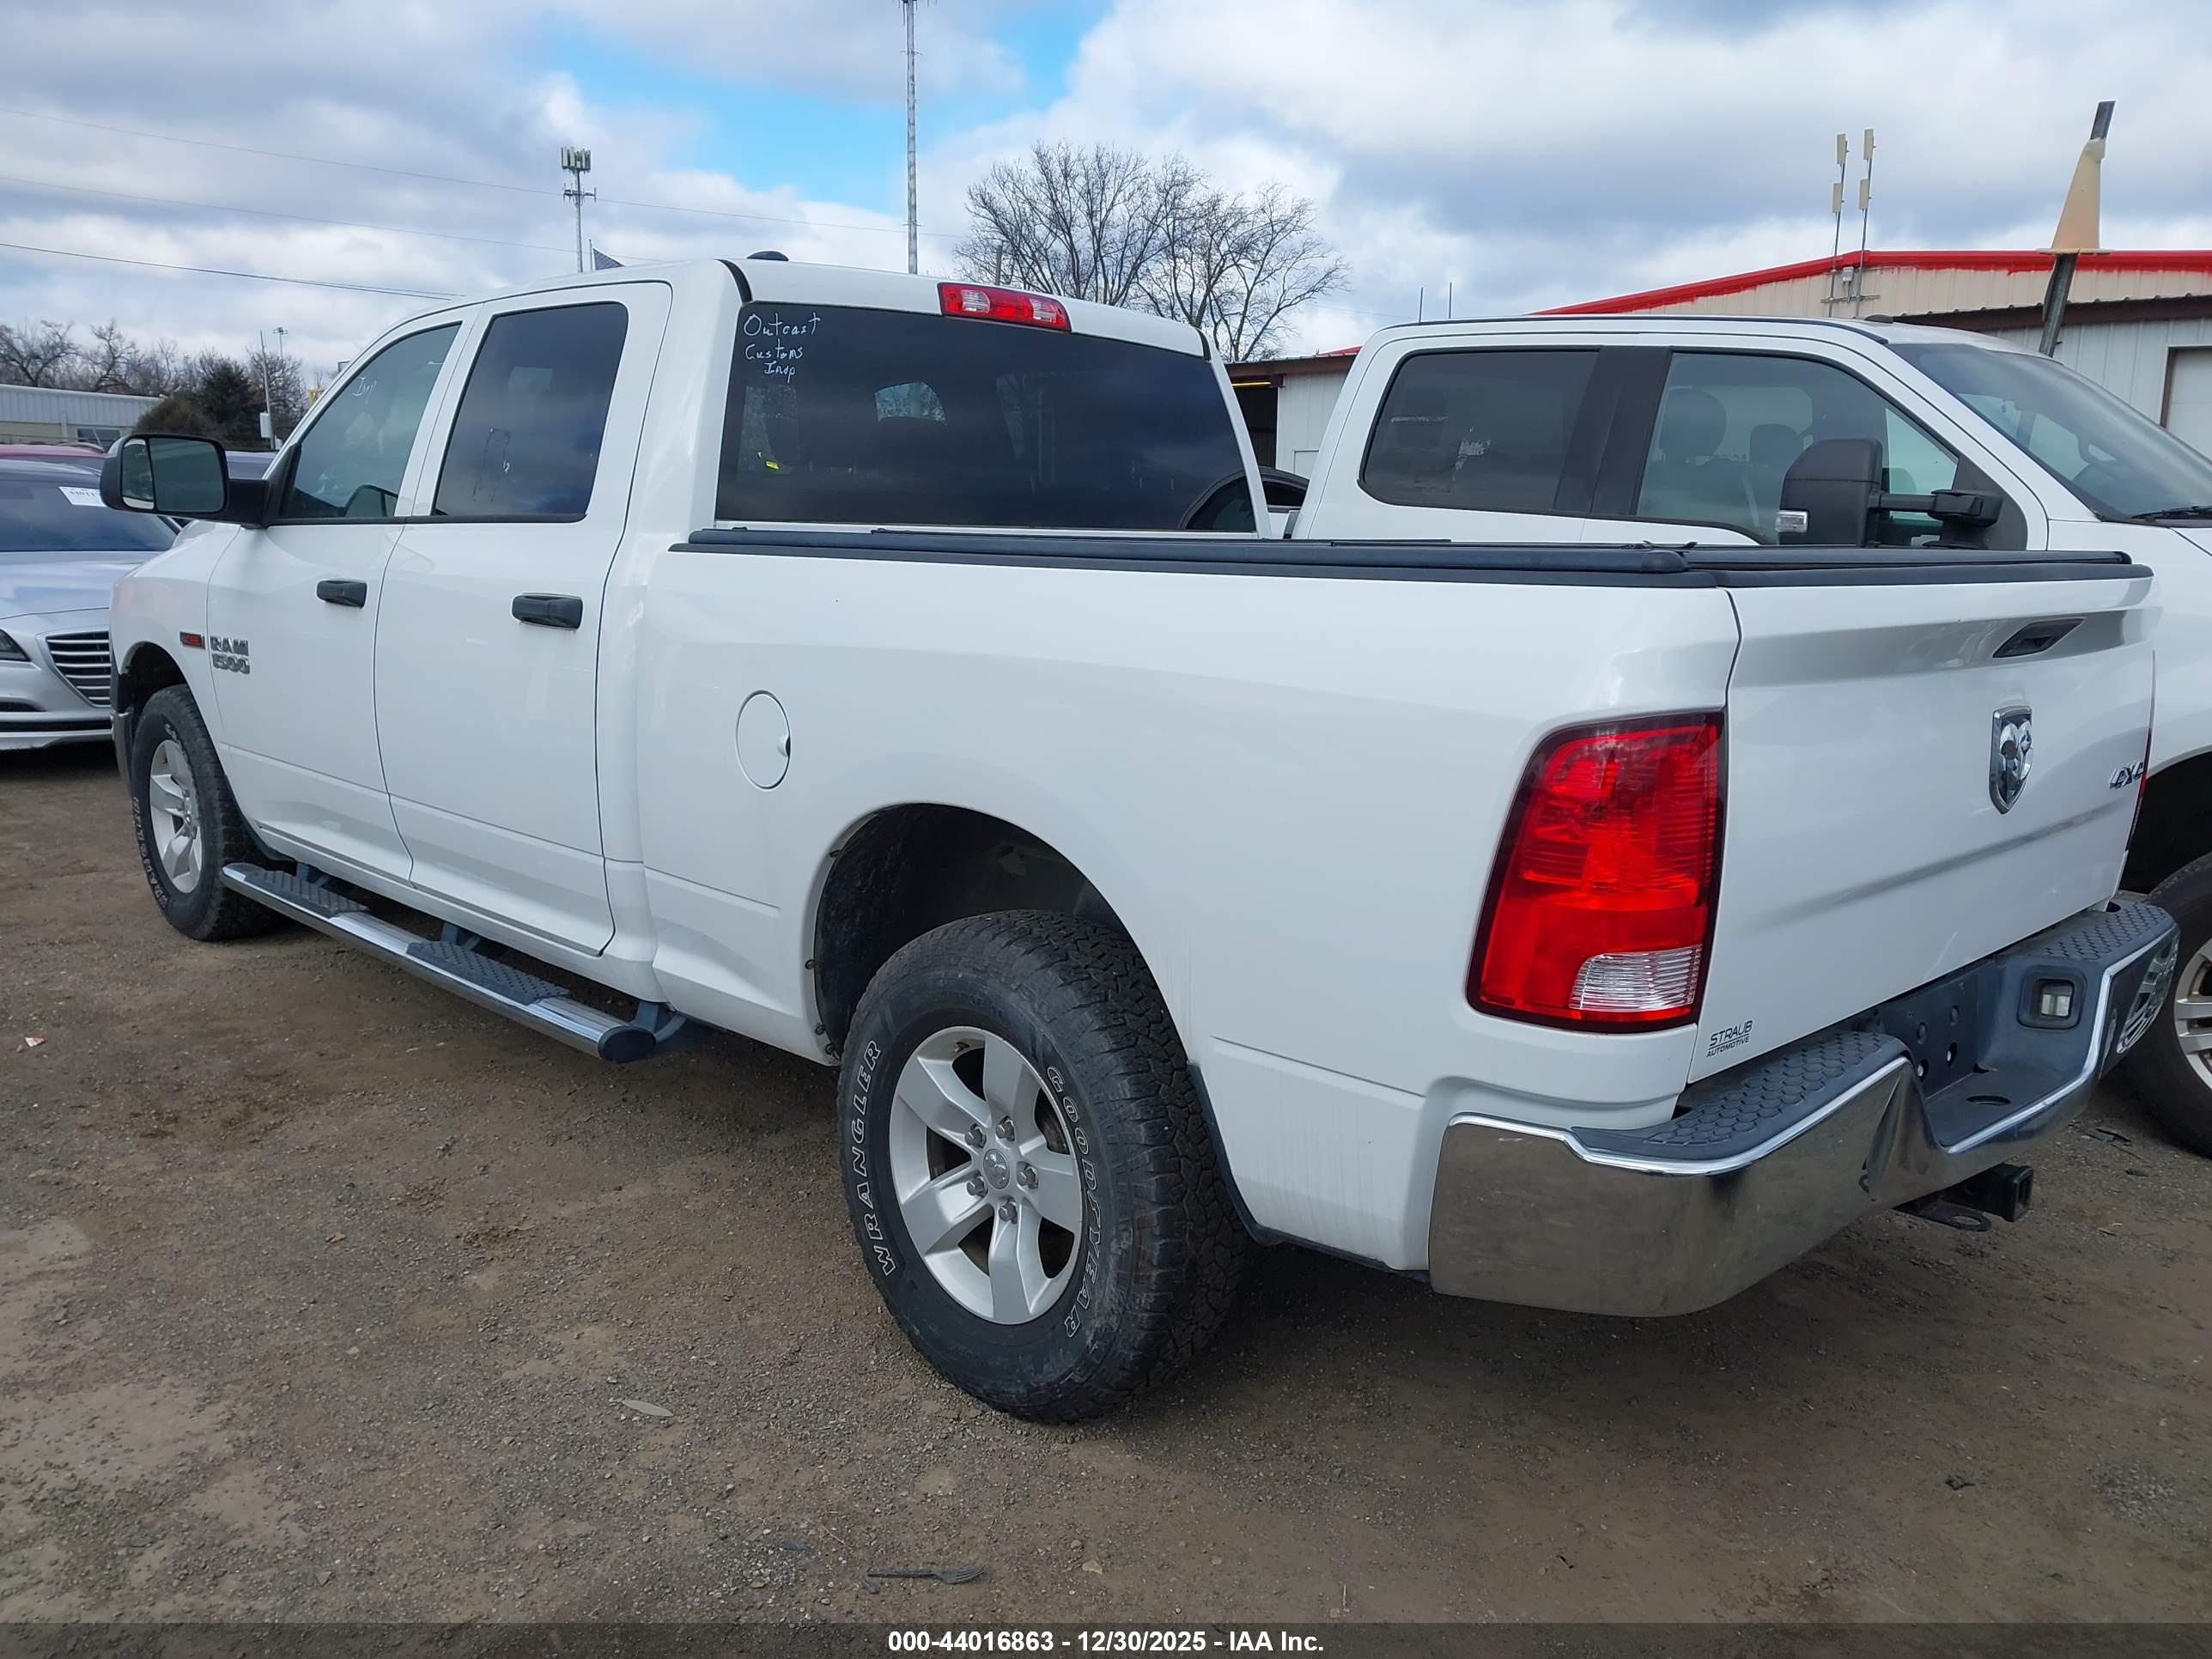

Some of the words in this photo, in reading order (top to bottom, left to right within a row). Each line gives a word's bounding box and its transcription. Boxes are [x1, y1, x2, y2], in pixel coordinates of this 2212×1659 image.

[743, 312, 821, 337] Outcast
[744, 337, 804, 360] Customs
[210, 635, 249, 656] RAM
[211, 653, 251, 675] 1500
[1709, 1020, 1753, 1047] STRAUB
[1706, 1036, 1750, 1058] AUTOMOTIVE
[848, 1039, 898, 1278] WRANGLER
[1045, 1065, 1103, 1340] GOODYEAR
